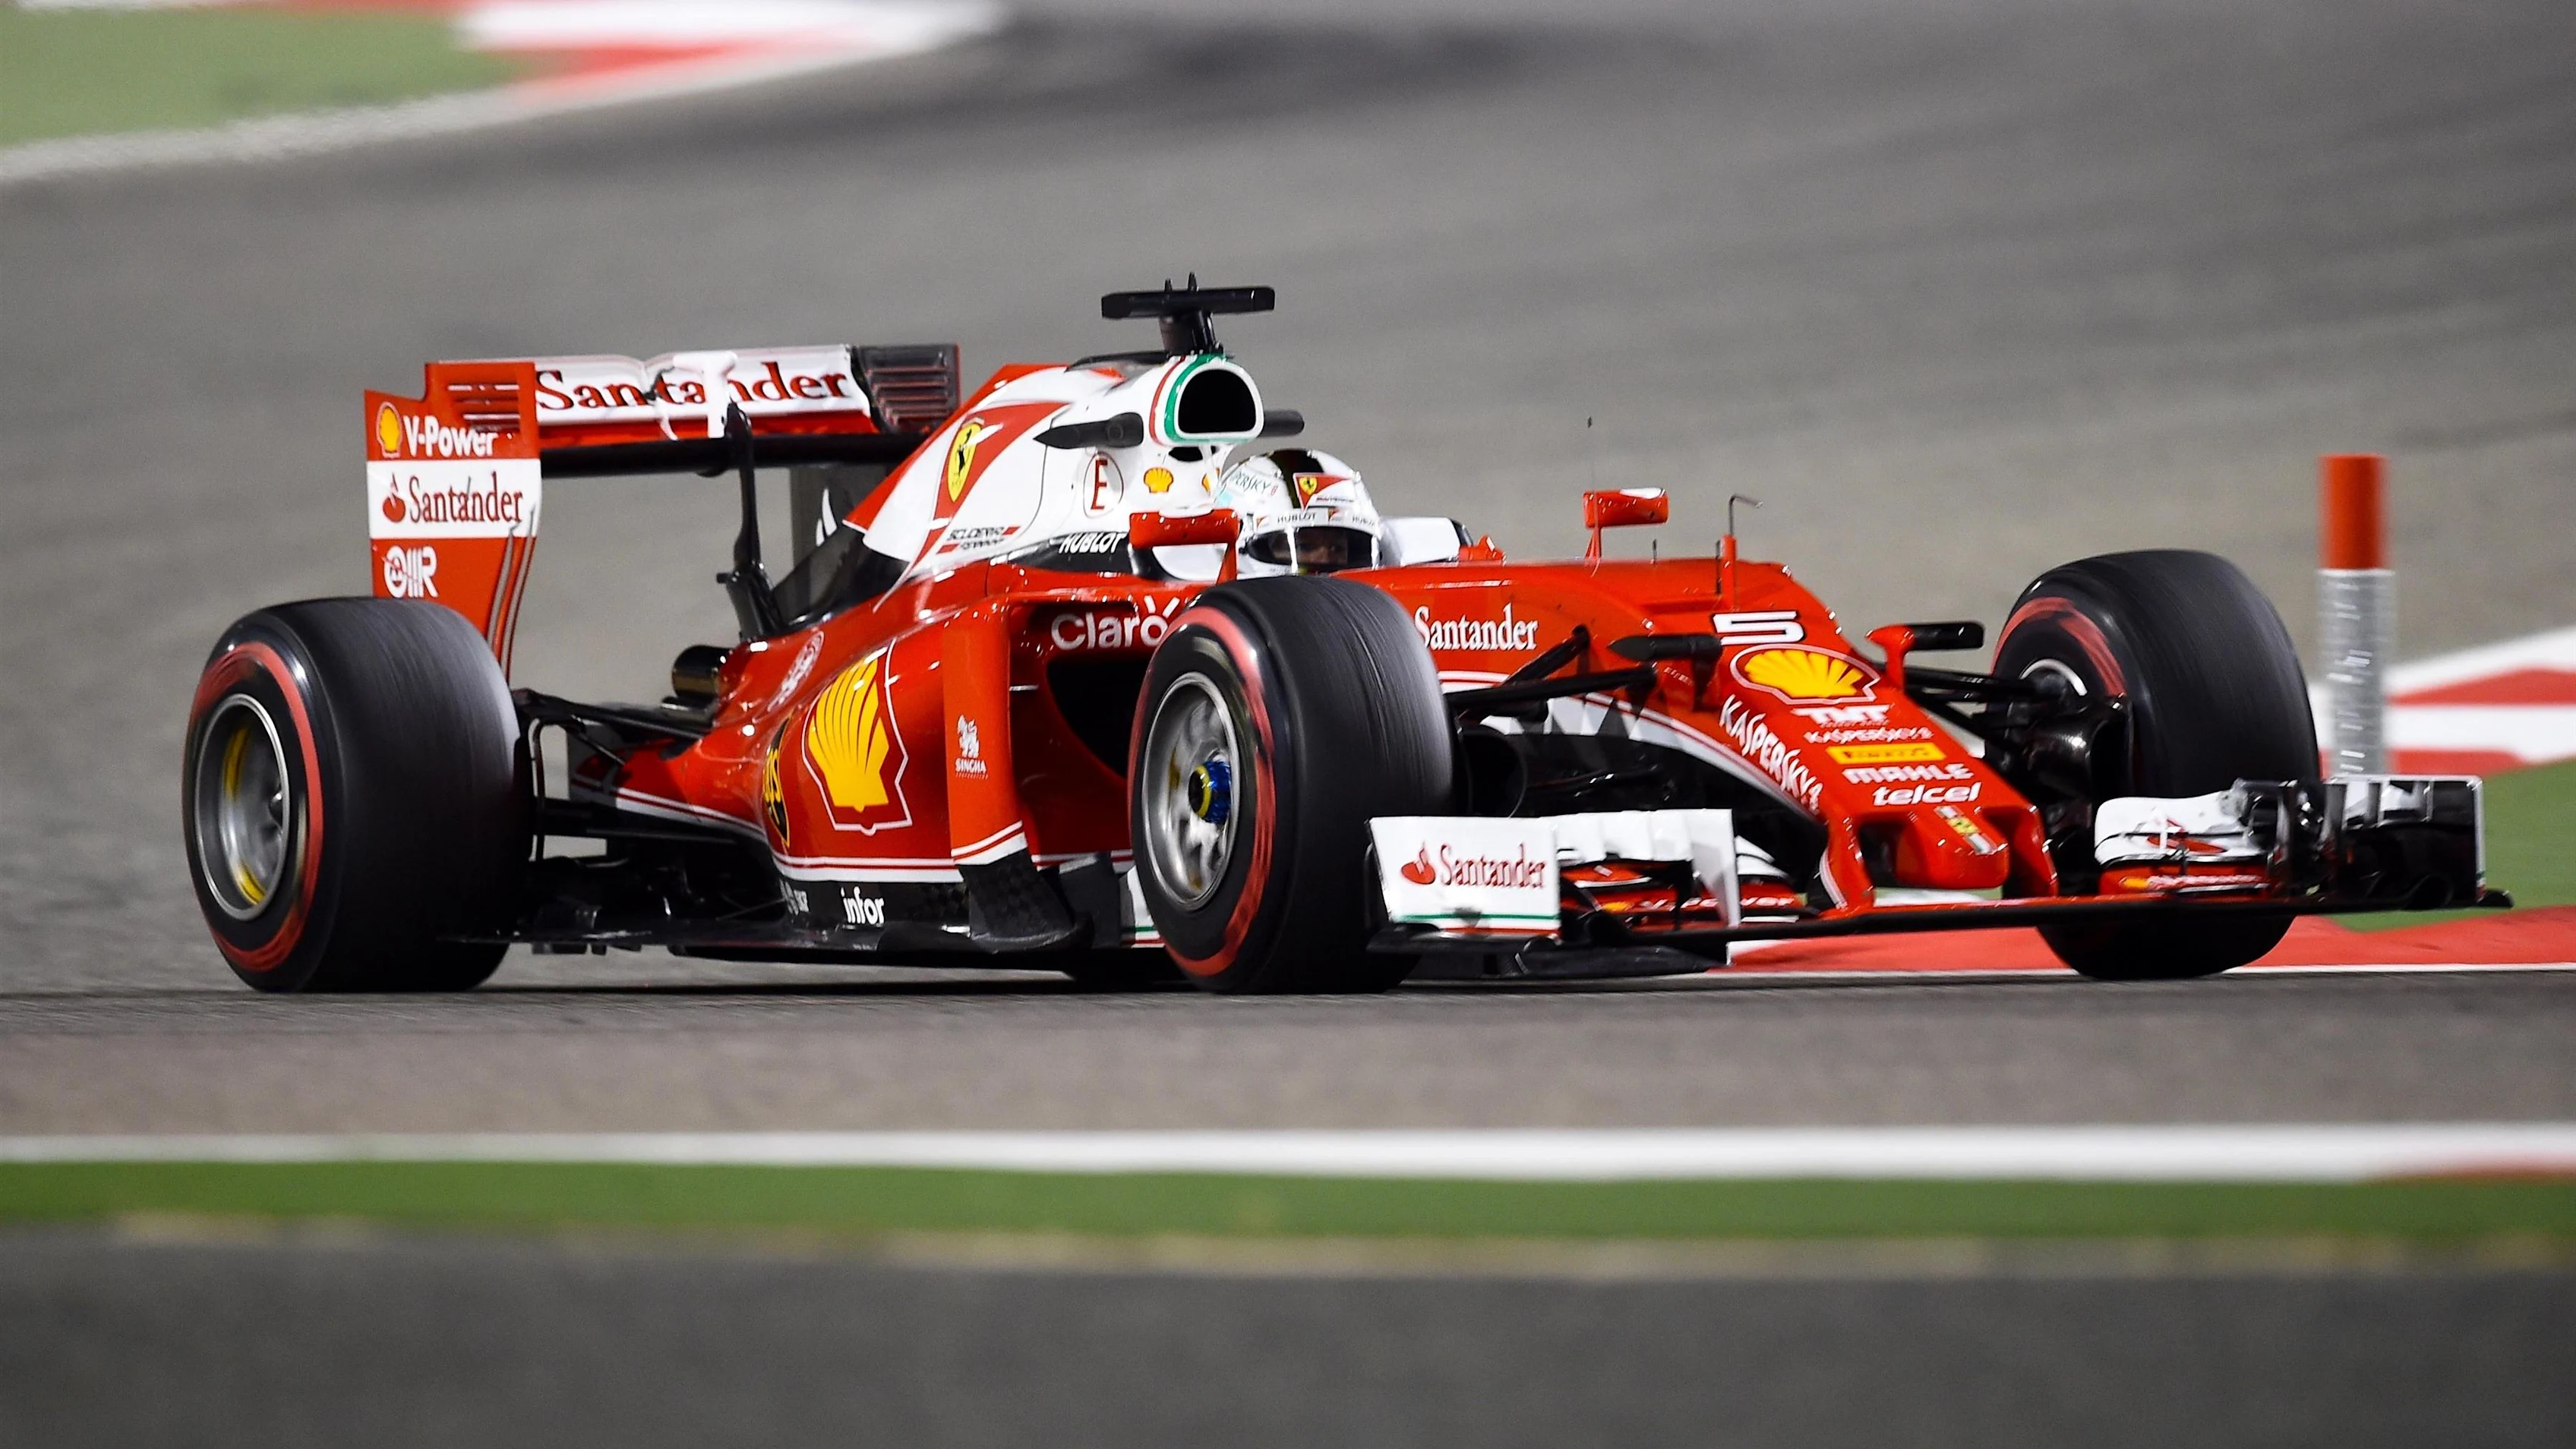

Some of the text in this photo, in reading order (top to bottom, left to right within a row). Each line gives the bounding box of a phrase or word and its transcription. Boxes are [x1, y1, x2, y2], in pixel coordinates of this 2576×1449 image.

[403, 415, 498, 456] V-Power
[409, 471, 523, 523] Santander
[1058, 532, 1128, 554] HUBLOT
[1051, 595, 1180, 650] Claro
[1414, 602, 1539, 651] Santander
[1713, 611, 1804, 646] 5
[1719, 694, 1818, 803] KASPERSKY
[1842, 763, 1975, 784] MAHLE
[1872, 781, 1982, 807] telcel
[1440, 842, 1545, 888] Santander
[841, 886, 885, 925] infor
